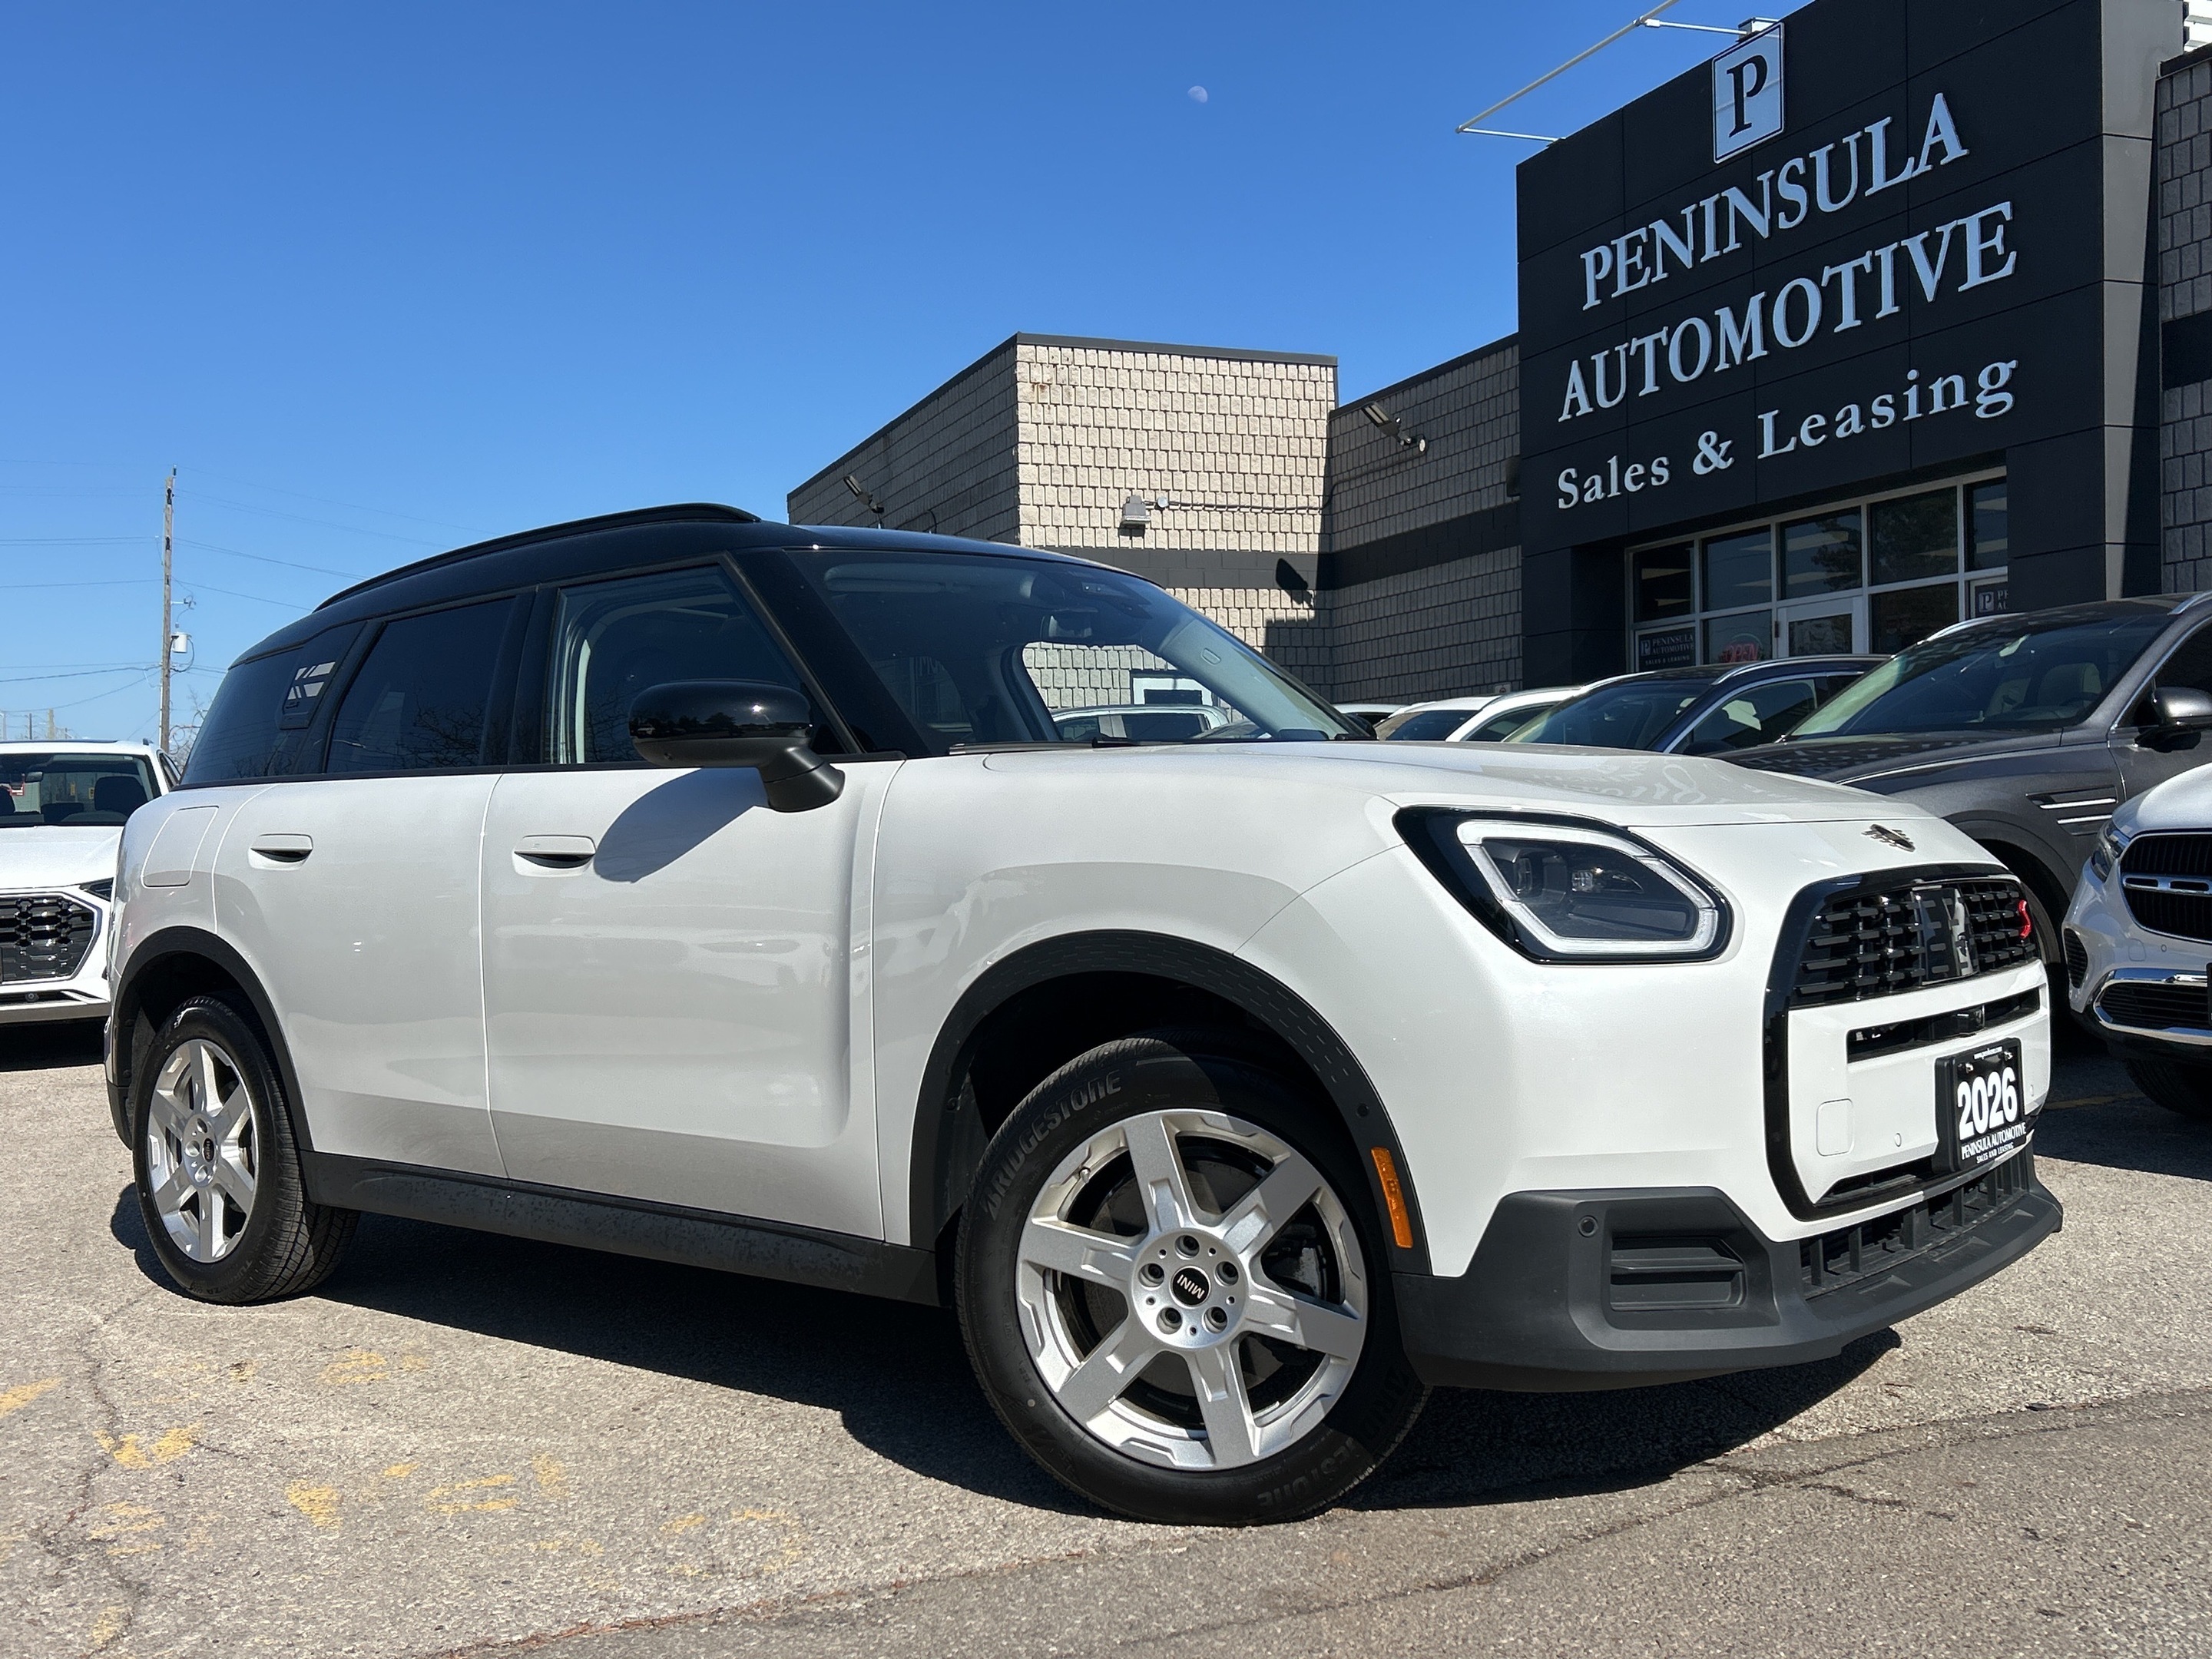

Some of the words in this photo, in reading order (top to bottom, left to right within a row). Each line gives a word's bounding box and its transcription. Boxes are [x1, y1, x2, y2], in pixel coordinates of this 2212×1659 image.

[1727, 54, 1768, 138] P
[1580, 92, 1969, 311] PENINSULA
[1558, 201, 2018, 423] AUTOMOTIVE
[1558, 456, 1671, 510] Sales
[1693, 431, 1734, 476] &
[1758, 359, 2019, 459] Leasing
[1982, 593, 1992, 610] P
[1652, 634, 1694, 647] PENINSULA
[1652, 643, 1694, 655] AUTOMOTIVE
[1726, 643, 1758, 662] OPEN
[1957, 1066, 2018, 1141] 2026
[1961, 1136, 1992, 1160] PENINSULA
[1991, 1122, 2026, 1147] AUTOMOTIVE
[1177, 1274, 1205, 1299] MINI
